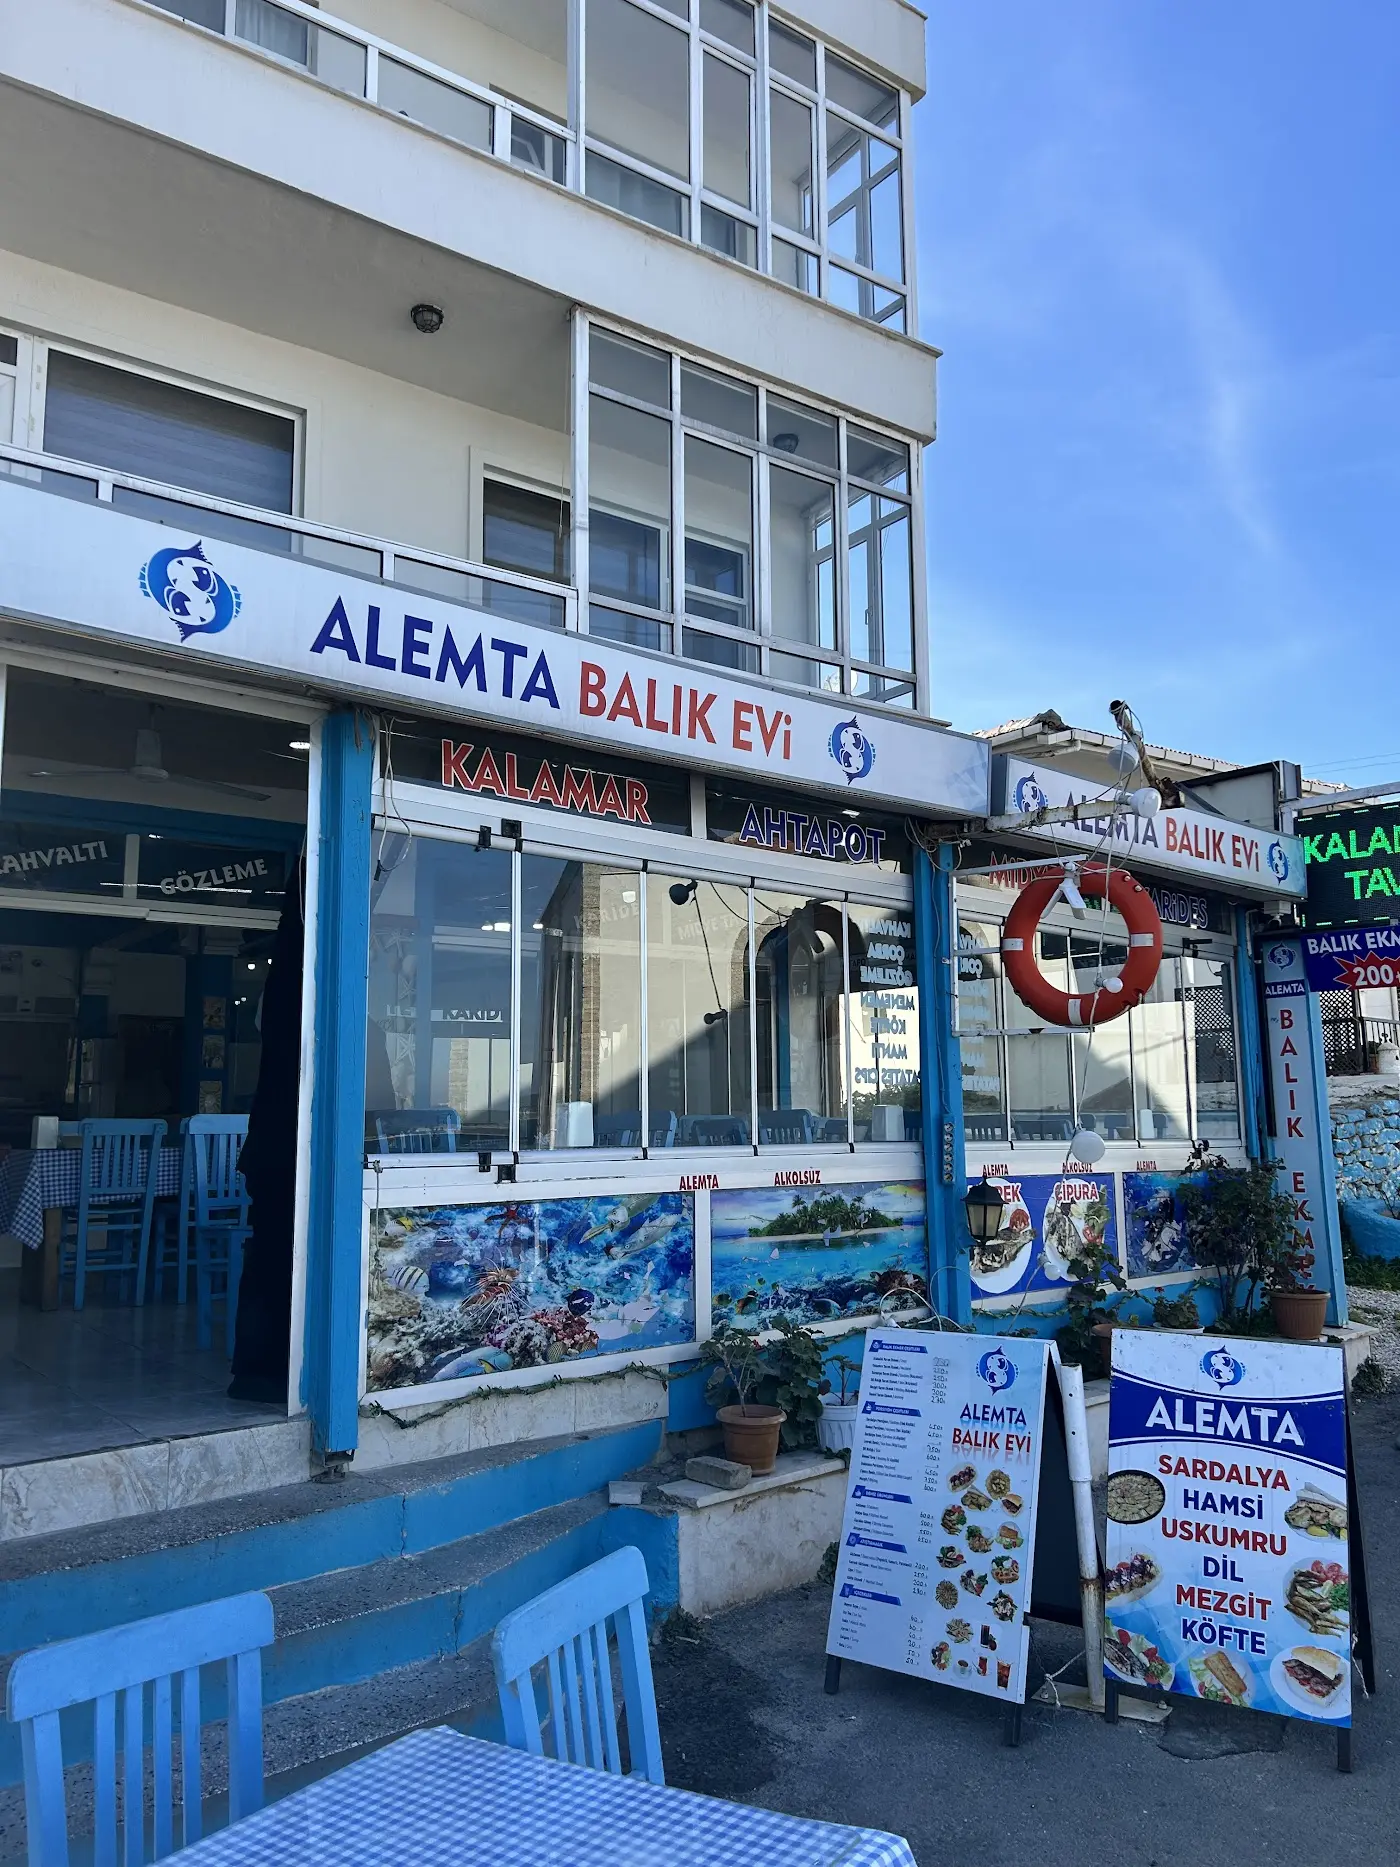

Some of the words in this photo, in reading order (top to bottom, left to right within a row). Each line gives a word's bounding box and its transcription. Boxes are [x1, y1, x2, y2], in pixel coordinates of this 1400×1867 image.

[310, 596, 562, 709] ALEMTA
[580, 660, 718, 744] BALIK
[441, 738, 653, 825] KALAMAR
[738, 803, 886, 864] AHTAPOT
[1166, 816, 1227, 864] BALIK
[1303, 825, 1400, 864] KALA
[0, 840, 108, 875] AHVALTI
[160, 858, 268, 895] GÖZLEME
[1307, 933, 1362, 955] BALIK
[1265, 982, 1305, 996] ALEMTA
[1279, 1008, 1304, 1138] BALIK
[679, 1174, 719, 1190] ALEMTA
[774, 1170, 821, 1186] ALKOLSUZ
[982, 1164, 1009, 1177] ALEMTA
[1136, 1160, 1157, 1171] ALEMTA
[960, 1403, 1027, 1426] ALEMTA
[1145, 1395, 1305, 1447] ALEMTA
[952, 1428, 1001, 1450] BALIK
[1005, 1431, 1032, 1453] EVİ
[1158, 1454, 1291, 1492] SARDALYA
[1183, 1488, 1264, 1520] HAMSİ
[1161, 1517, 1287, 1556] USKUMRU
[1203, 1553, 1244, 1583] DİL
[1176, 1583, 1272, 1621] MEZGİT
[1182, 1616, 1266, 1655] KÖFTE
